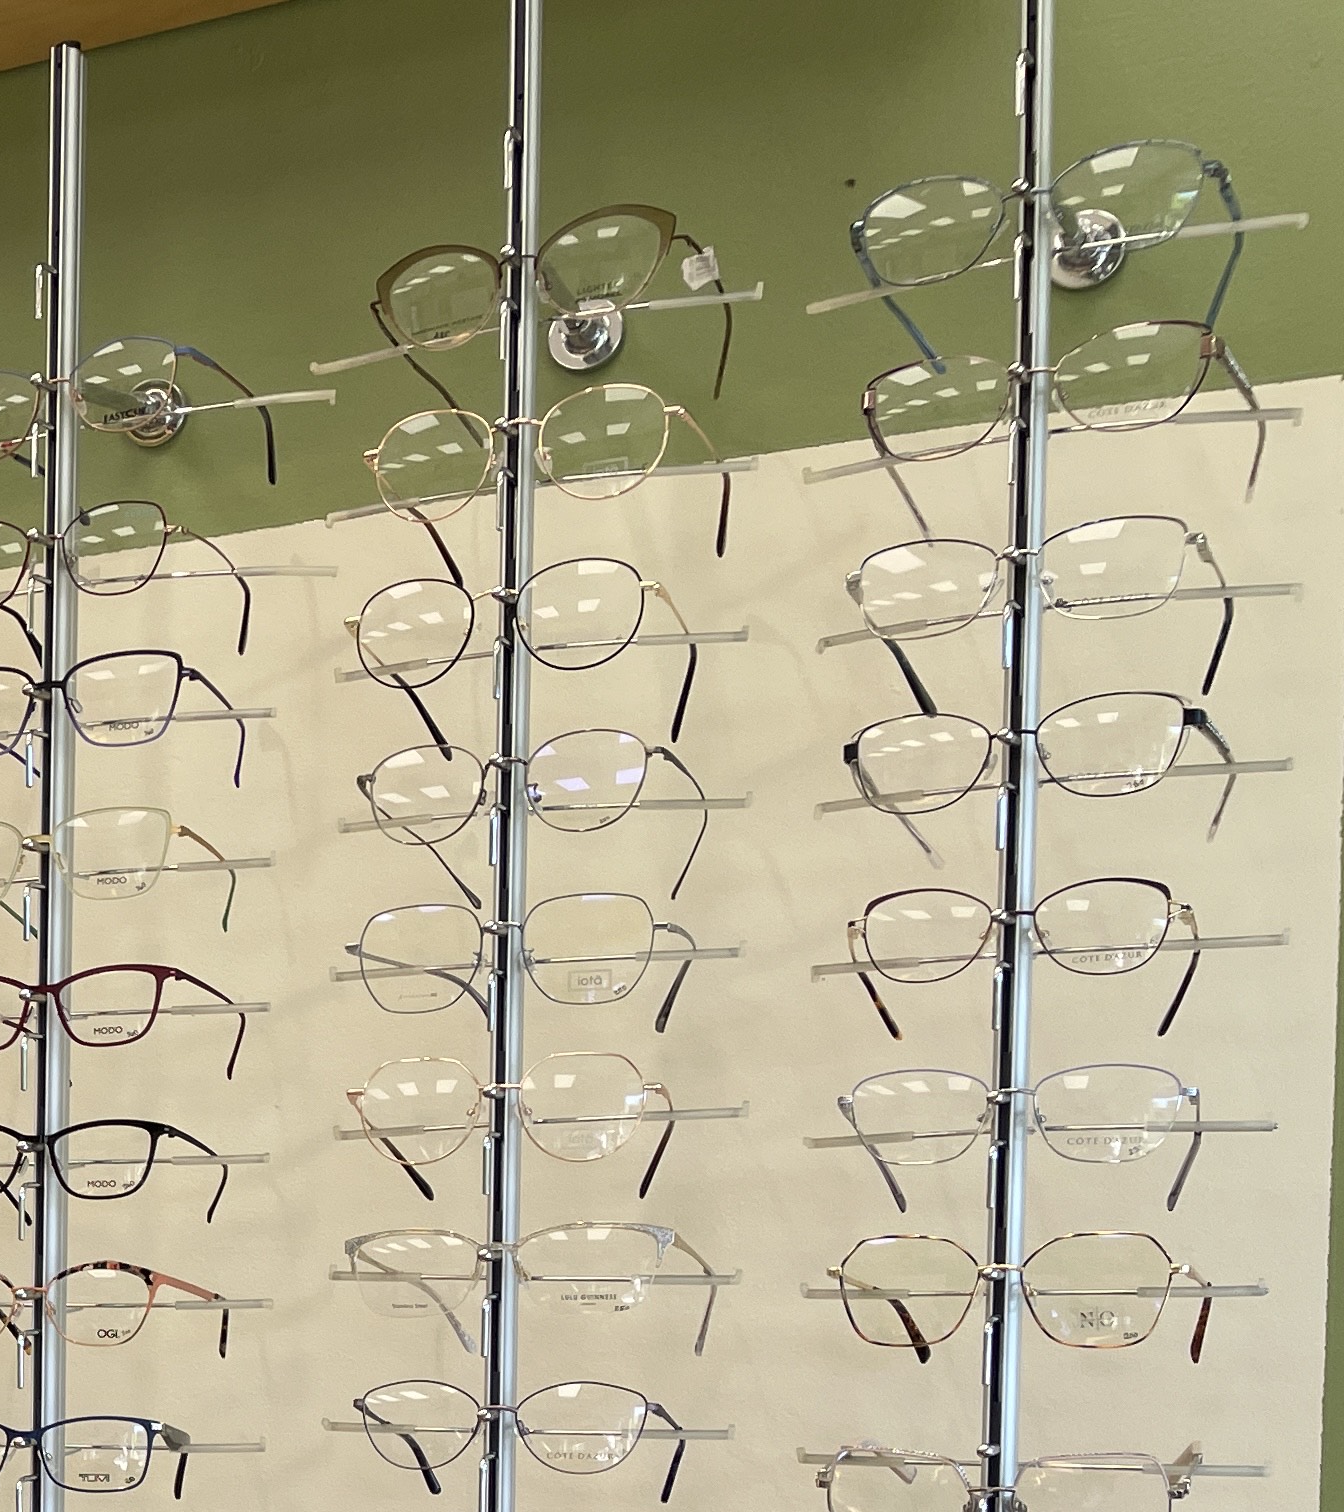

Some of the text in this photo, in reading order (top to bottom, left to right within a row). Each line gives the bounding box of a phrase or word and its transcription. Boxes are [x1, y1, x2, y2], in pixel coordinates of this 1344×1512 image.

[109, 721, 140, 731] MODO
[97, 876, 127, 885] MODO
[93, 1025, 123, 1035] MODO
[87, 1179, 116, 1188] MODO
[97, 1328, 120, 1339] OGI
